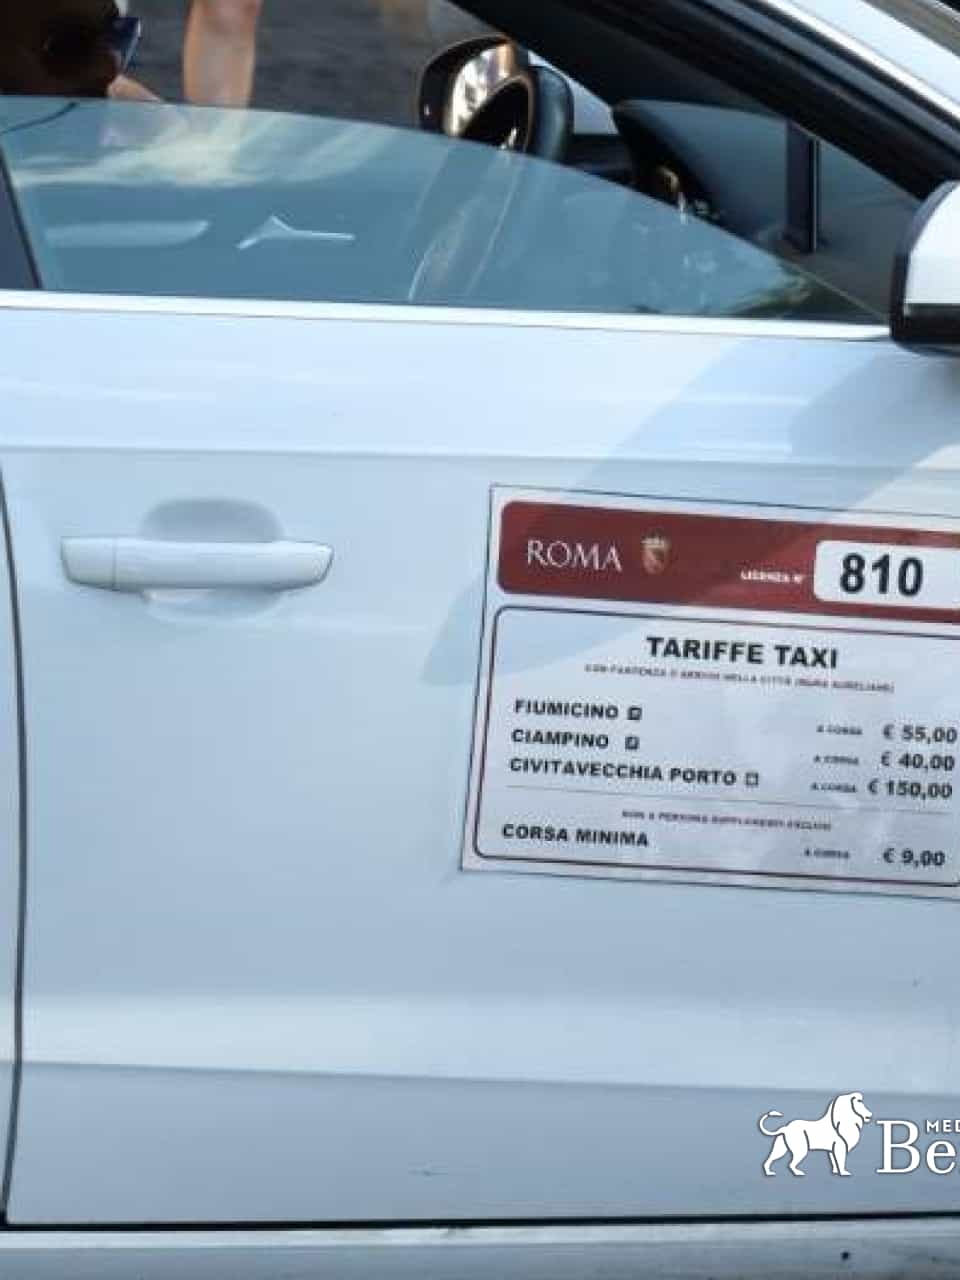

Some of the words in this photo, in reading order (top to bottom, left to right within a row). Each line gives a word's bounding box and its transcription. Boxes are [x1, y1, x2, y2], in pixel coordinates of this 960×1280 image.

[527, 539, 622, 572] ROMA
[839, 552, 924, 597] 810
[646, 636, 764, 665] TARIFFE
[774, 645, 838, 669] TAXI
[514, 699, 619, 720] FIUMICINO
[883, 724, 894, 740] €
[902, 725, 958, 744] 55,00
[511, 728, 609, 750] CIAMPINO
[881, 751, 892, 767] €
[898, 753, 955, 771] 40,00
[509, 757, 663, 781] CIVITAVECCHIA
[670, 768, 737, 786] PORTO
[867, 778, 879, 796] €
[886, 780, 953, 800] 150,00
[502, 823, 568, 842] CORSA
[576, 828, 649, 846] MINIMA
[883, 847, 895, 863] €
[902, 848, 946, 867] 9,00
